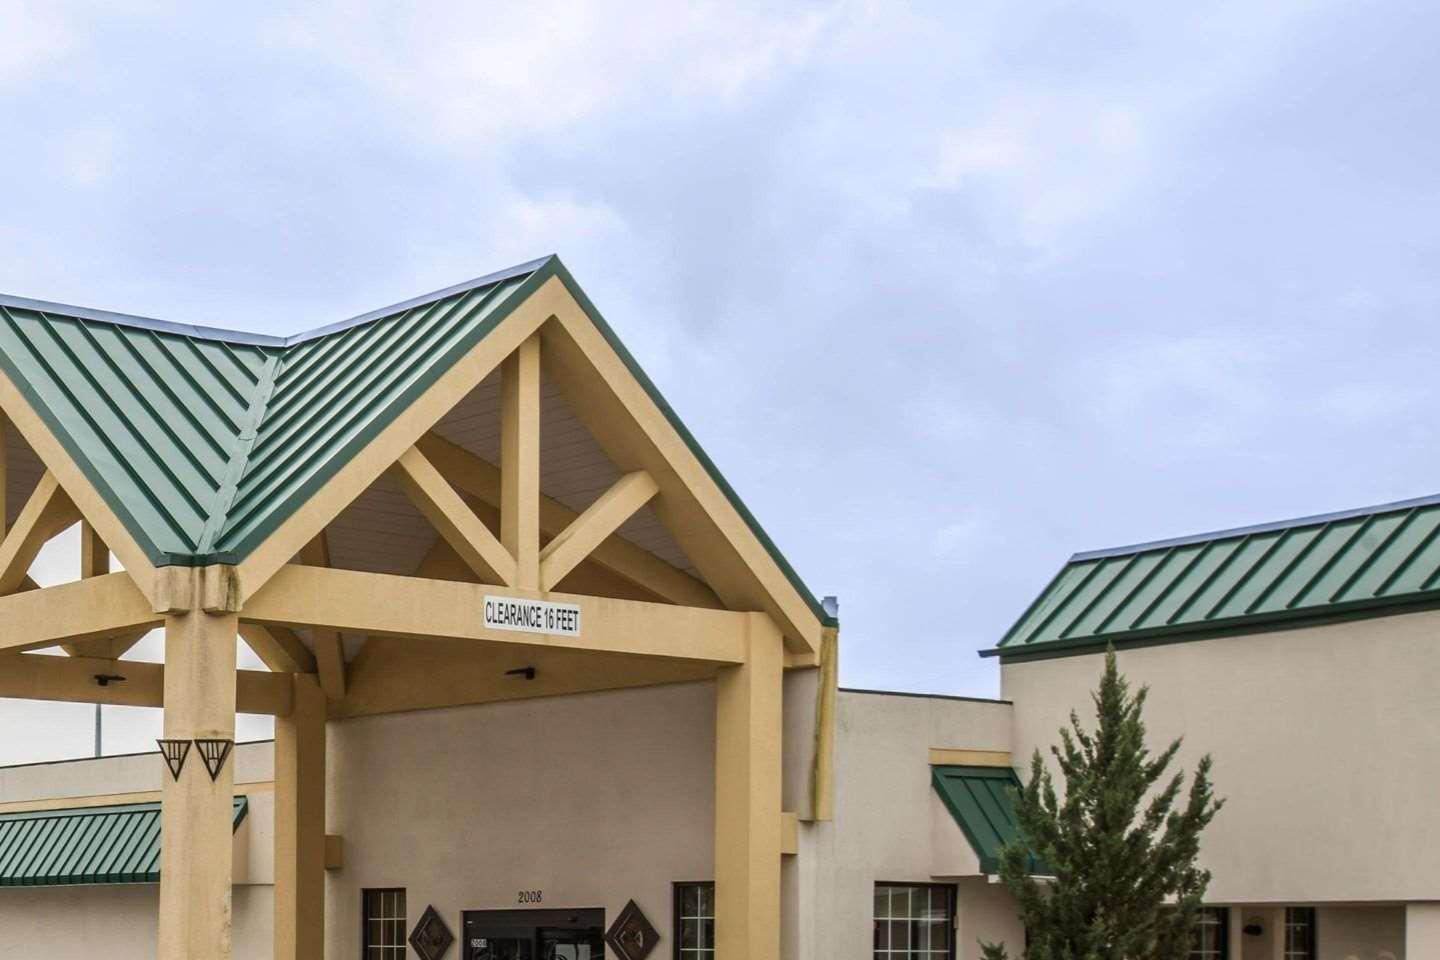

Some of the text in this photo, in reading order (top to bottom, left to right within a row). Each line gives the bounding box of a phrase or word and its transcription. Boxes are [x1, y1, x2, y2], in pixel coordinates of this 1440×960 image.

[485, 601, 579, 631] CLEARANCE 16 FEET
[518, 890, 542, 903] 2008
